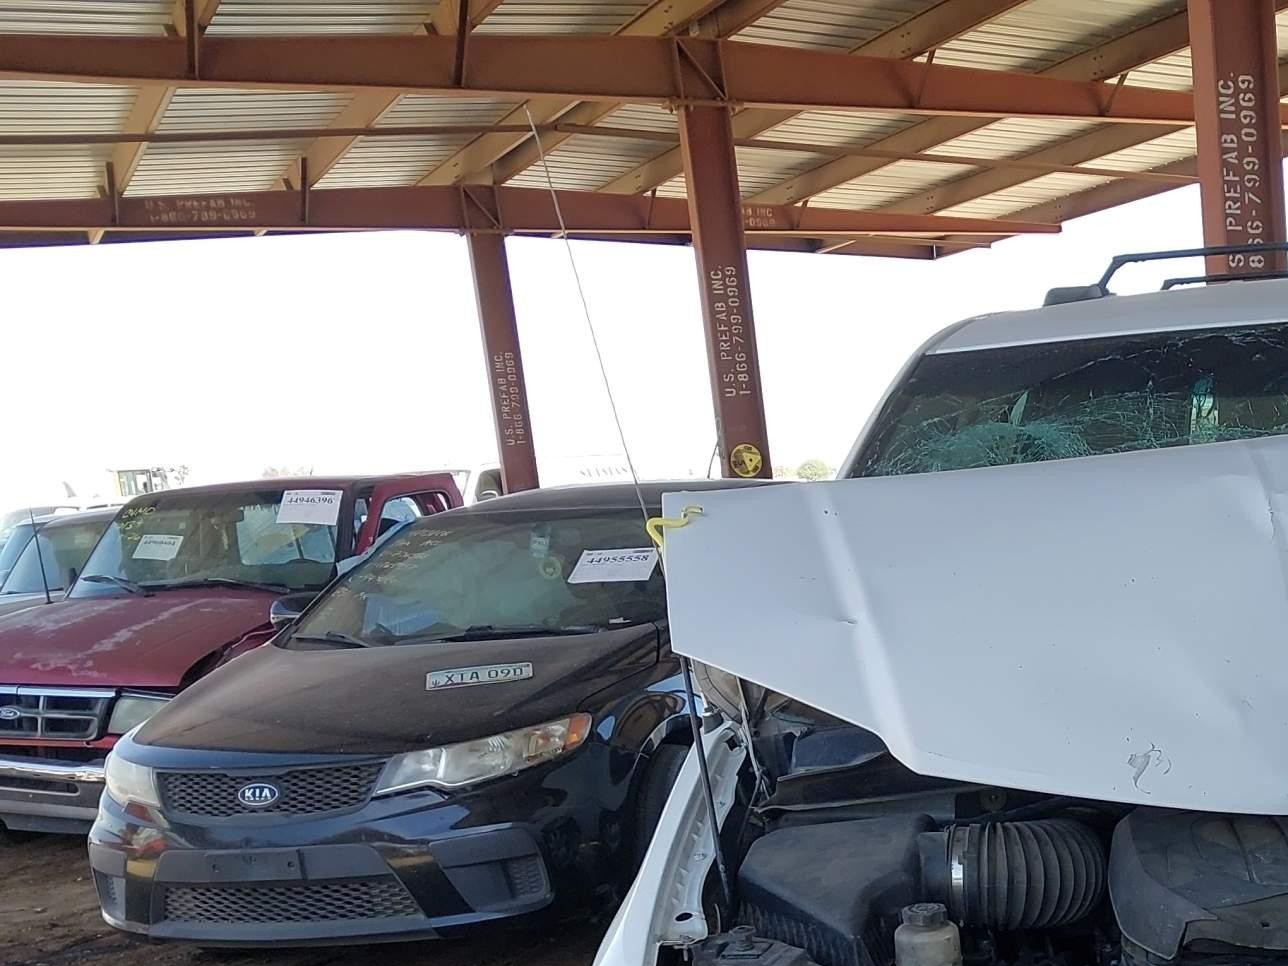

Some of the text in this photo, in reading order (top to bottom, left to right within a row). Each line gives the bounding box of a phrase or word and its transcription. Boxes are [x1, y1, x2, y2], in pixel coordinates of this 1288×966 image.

[1217, 71, 1236, 119] INC.
[1221, 133, 1243, 231] PREFAB
[709, 264, 737, 398] U.S. PREFAB INC.
[724, 265, 751, 396] 1-866-799-0969
[497, 377, 512, 420] PREFAB
[286, 495, 334, 505] 44946396
[586, 554, 650, 565] 44955558
[244, 787, 272, 801] KIA
